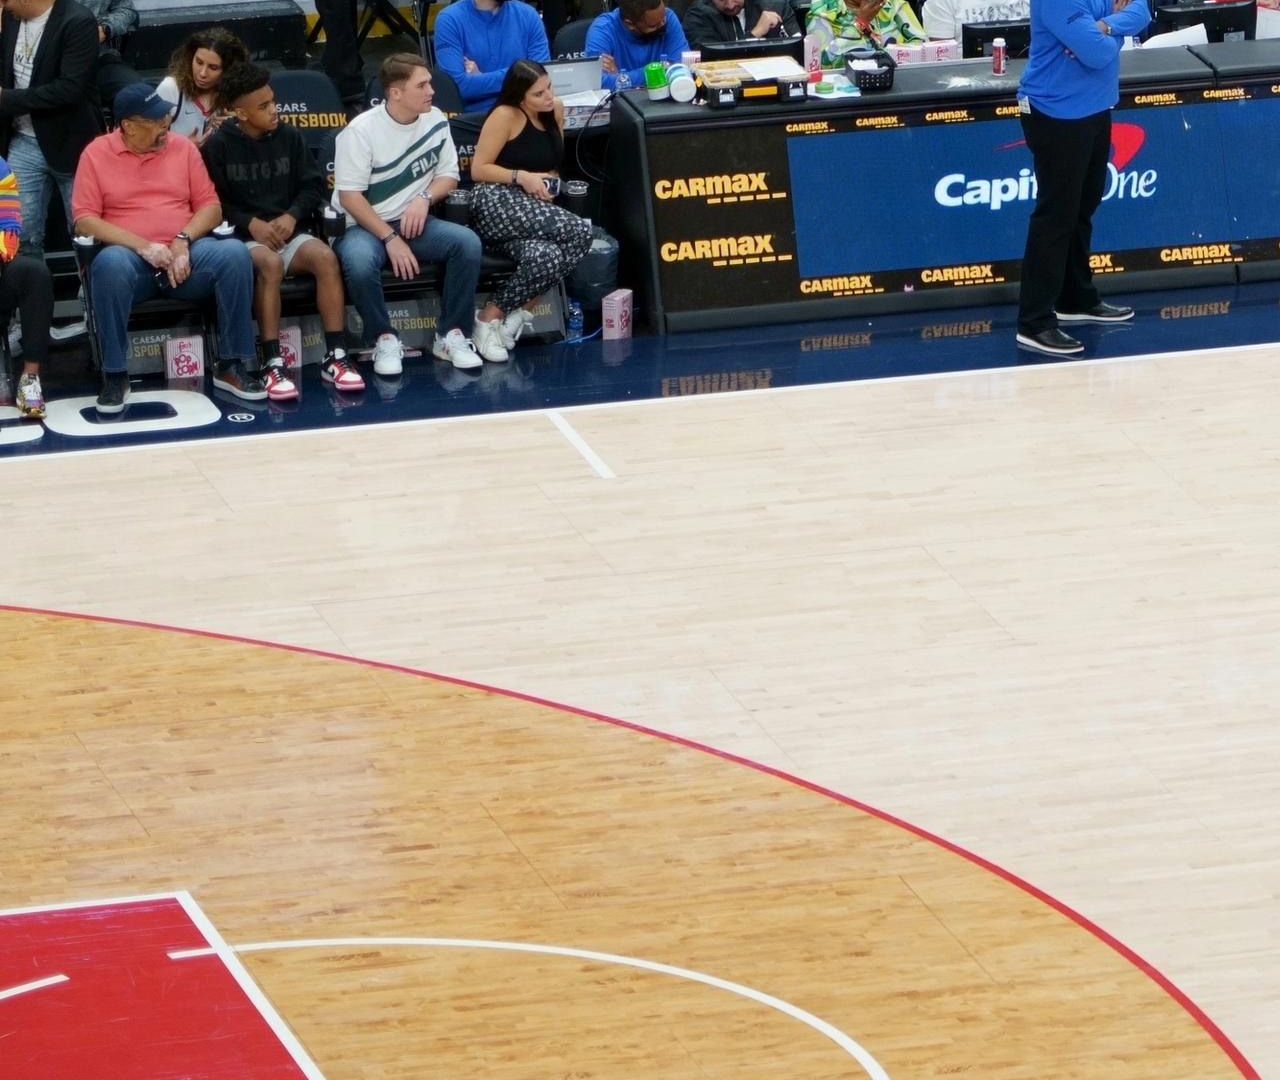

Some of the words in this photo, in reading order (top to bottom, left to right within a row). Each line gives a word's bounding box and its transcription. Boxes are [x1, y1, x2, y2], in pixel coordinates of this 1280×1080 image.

[276, 102, 307, 114] SARS
[411, 150, 438, 178] FILA
[387, 309, 410, 319] SARS
[174, 352, 192, 367] POP
[175, 363, 200, 378] CORN
